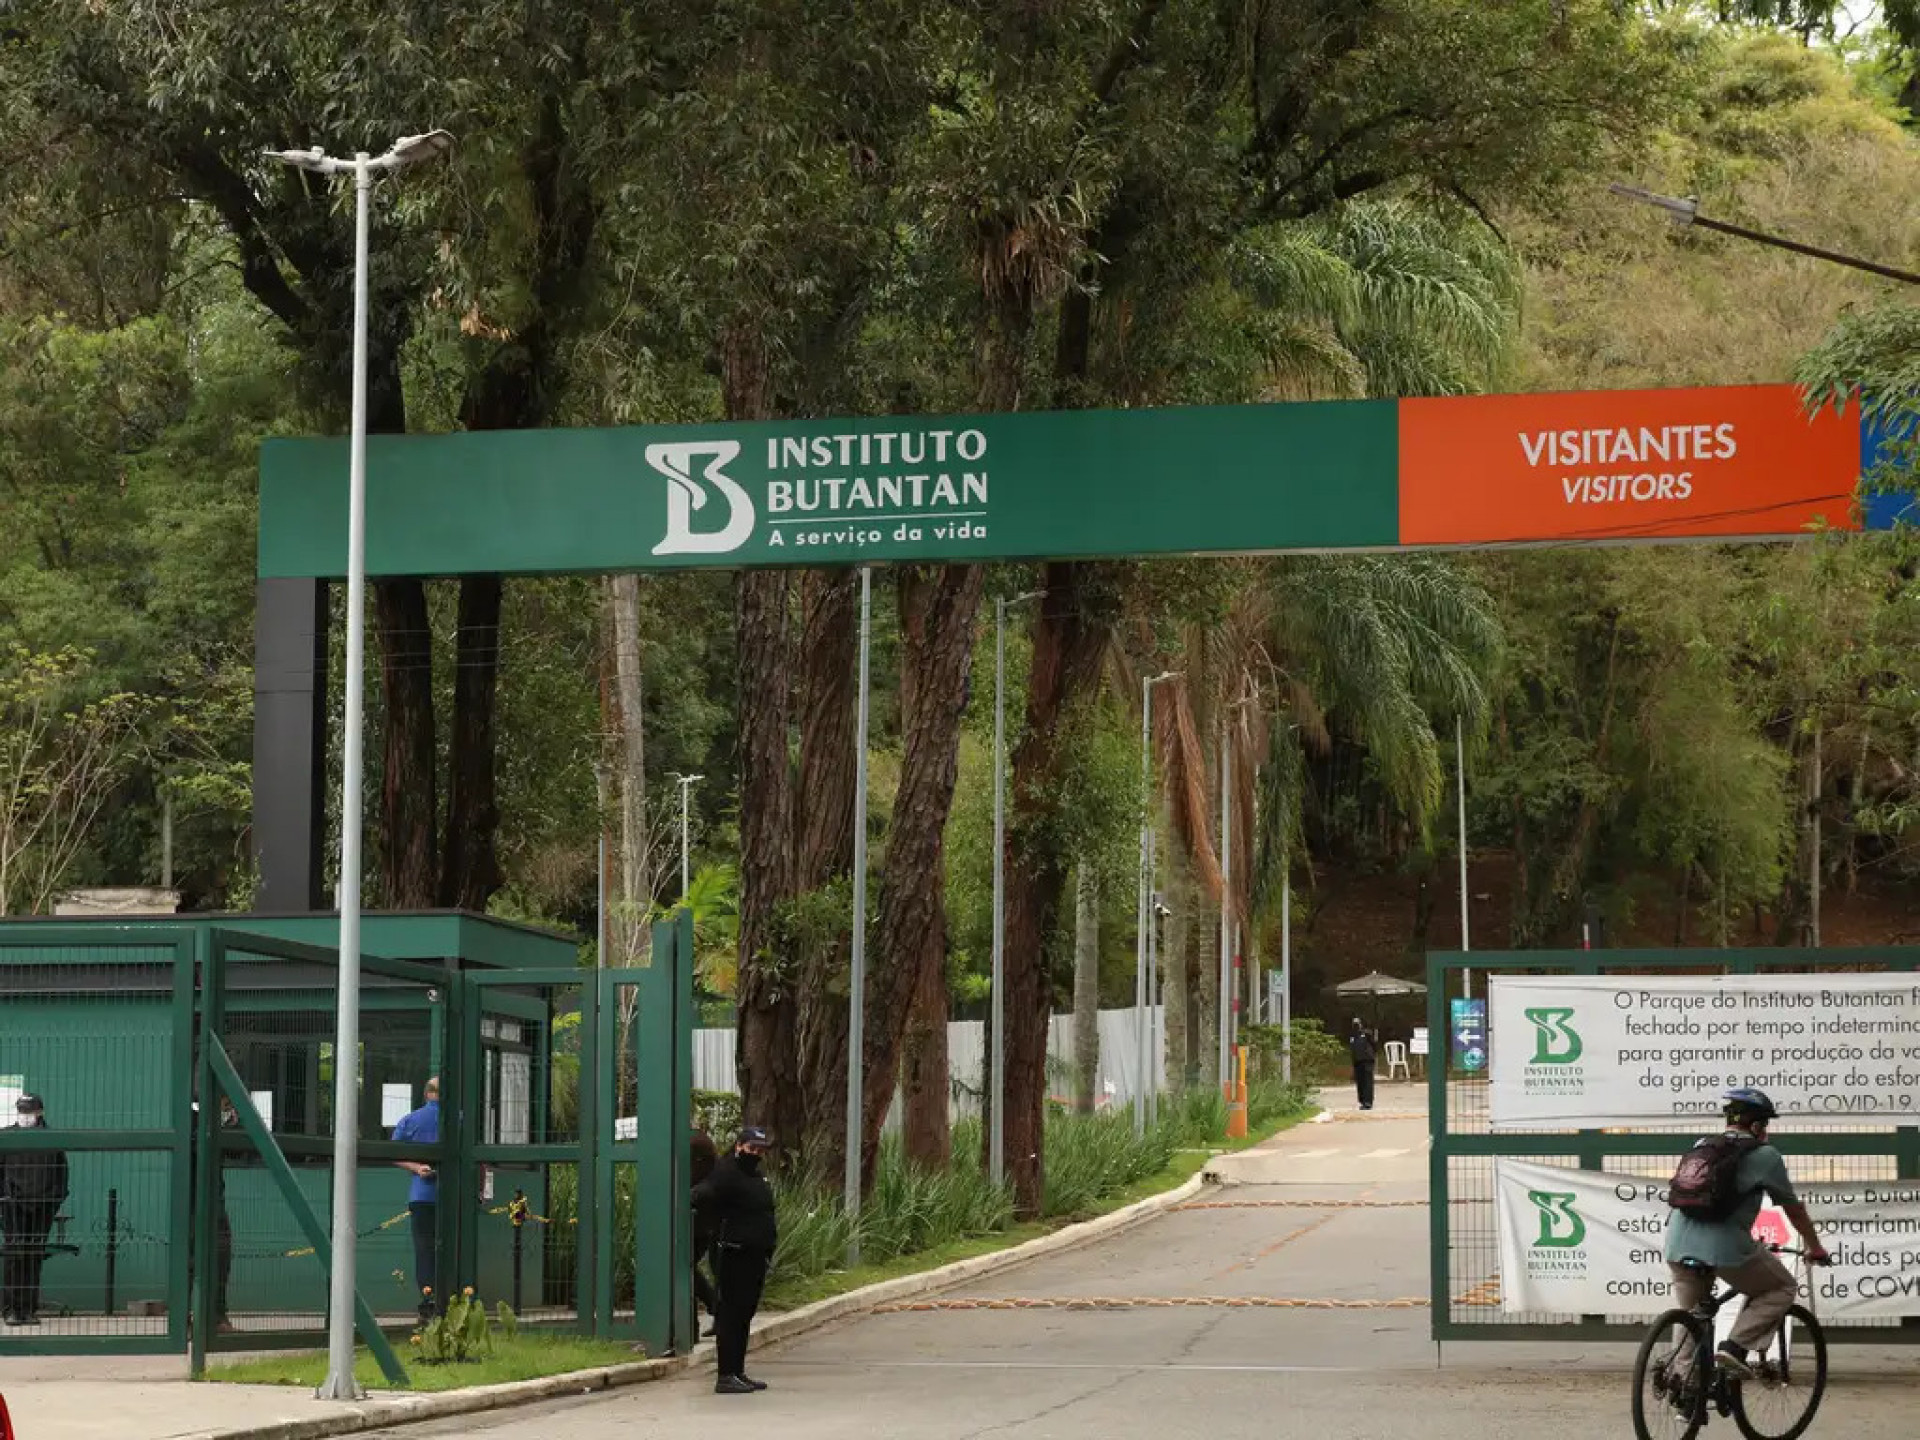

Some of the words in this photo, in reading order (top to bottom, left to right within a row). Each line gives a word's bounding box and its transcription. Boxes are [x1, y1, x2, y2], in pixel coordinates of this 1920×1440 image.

[768, 429, 988, 469] INSTITUTO
[1518, 423, 1737, 467] VISITANTES
[768, 472, 988, 512] BUTANTAN
[1561, 472, 1693, 503] VISITORS
[768, 529, 785, 546] A
[795, 526, 882, 546] serviço
[893, 522, 922, 541] da
[933, 521, 987, 539] vida
[1614, 991, 1634, 1009] O
[1640, 991, 1705, 1013] Parque
[1711, 989, 1737, 1009] do
[1743, 990, 1814, 1009] Instituto
[1821, 989, 1904, 1007] Butantan
[1625, 1014, 1701, 1035] fechado
[1707, 1022, 1740, 1040] por
[1746, 1019, 1804, 1039] tempo
[1618, 1049, 1663, 1065] para
[1669, 1044, 1746, 1066] garantir
[1752, 1049, 1764, 1060] a
[1771, 1041, 1863, 1065] produção
[1869, 1040, 1895, 1059] da
[1639, 1067, 1664, 1087] da
[1670, 1068, 1720, 1093] gripe
[1726, 1074, 1737, 1087] e
[1744, 1067, 1838, 1091] participar
[1844, 1066, 1869, 1086] do
[1615, 1183, 1637, 1202] O
[1617, 1213, 1661, 1233] está
[1629, 1249, 1662, 1264] em
[1820, 1273, 1849, 1298] de
